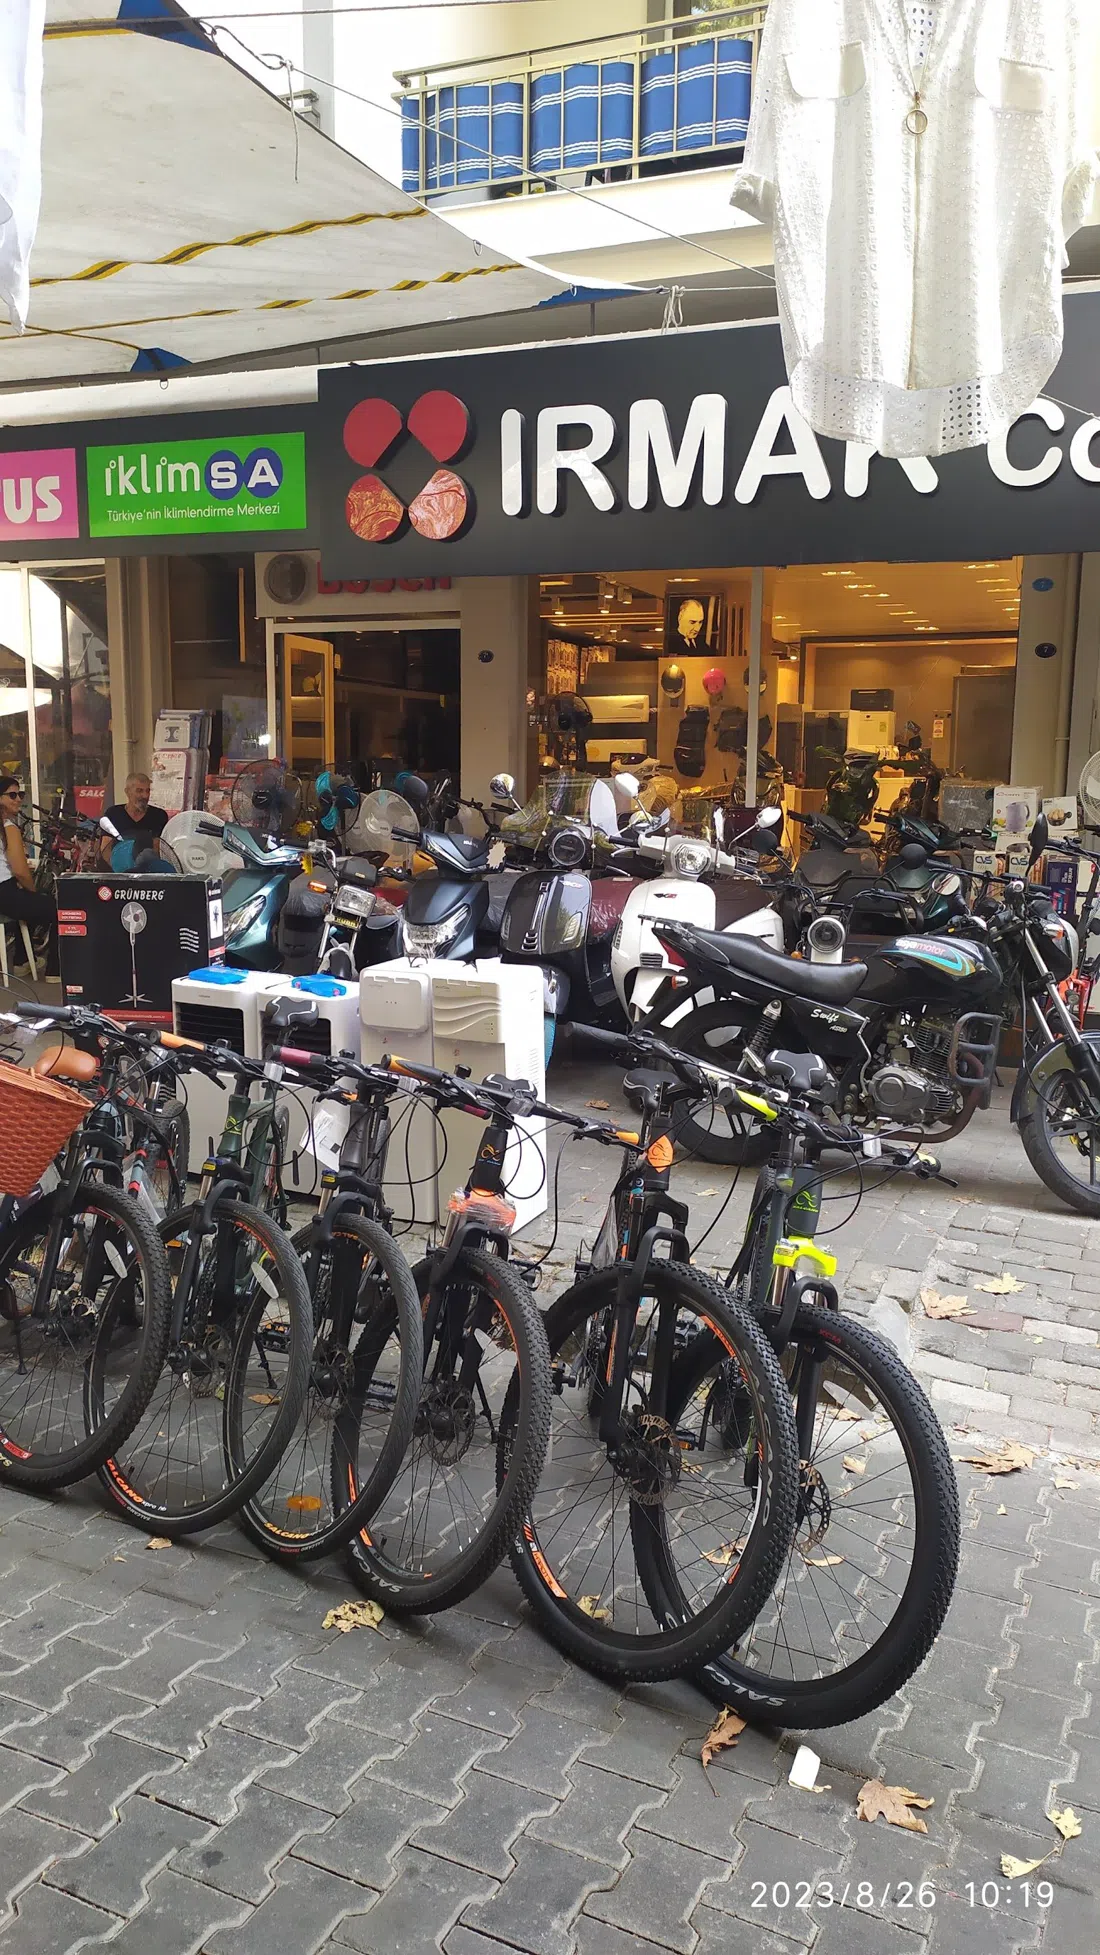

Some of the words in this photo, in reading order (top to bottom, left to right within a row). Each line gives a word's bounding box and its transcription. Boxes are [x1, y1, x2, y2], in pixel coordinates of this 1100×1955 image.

[0, 475, 63, 524] US
[107, 509, 161, 524] Türkiye'nin
[163, 505, 235, 520] İklimlendirme
[236, 502, 281, 517] Merkezi
[114, 887, 165, 901] GRÜNBERG
[810, 1008, 840, 1024] Swift
[263, 1521, 311, 1540] SALCANO
